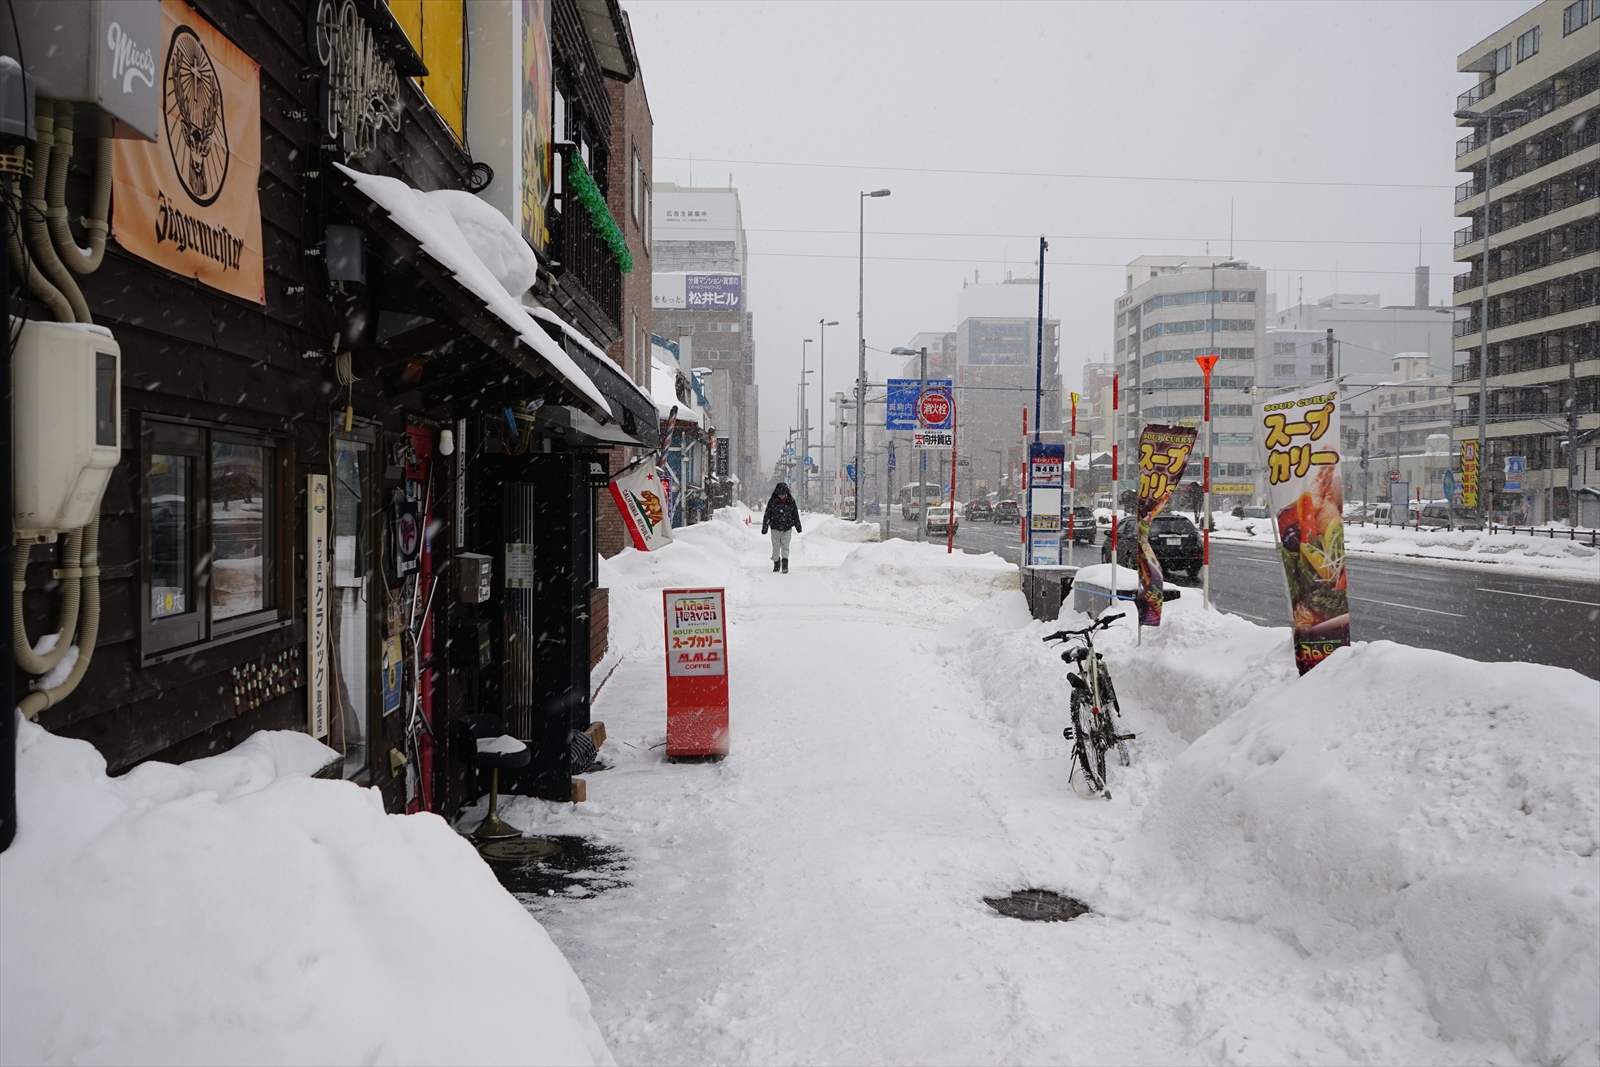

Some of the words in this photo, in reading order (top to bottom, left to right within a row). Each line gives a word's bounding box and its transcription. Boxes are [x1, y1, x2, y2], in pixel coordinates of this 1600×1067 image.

[688, 291, 738, 306] 松井ビル
[923, 403, 948, 415] 消火栓
[1263, 400, 1295, 413] SOUP
[1297, 390, 1338, 409] CURRY
[1263, 401, 1336, 450] スープ
[923, 435, 952, 445] 向井質店
[1142, 432, 1164, 441] SOUP
[1164, 434, 1194, 445] CURRY
[1139, 442, 1191, 475] スープ
[1267, 443, 1340, 486] カリー
[1139, 472, 1177, 500] カリー
[621, 489, 640, 518] CALIFORNIA
[635, 517, 653, 542] REPUBLIC
[674, 597, 714, 612] Chaos
[675, 610, 717, 628] Heaven
[694, 627, 721, 635] CURRY
[673, 636, 722, 649] スープカリー
